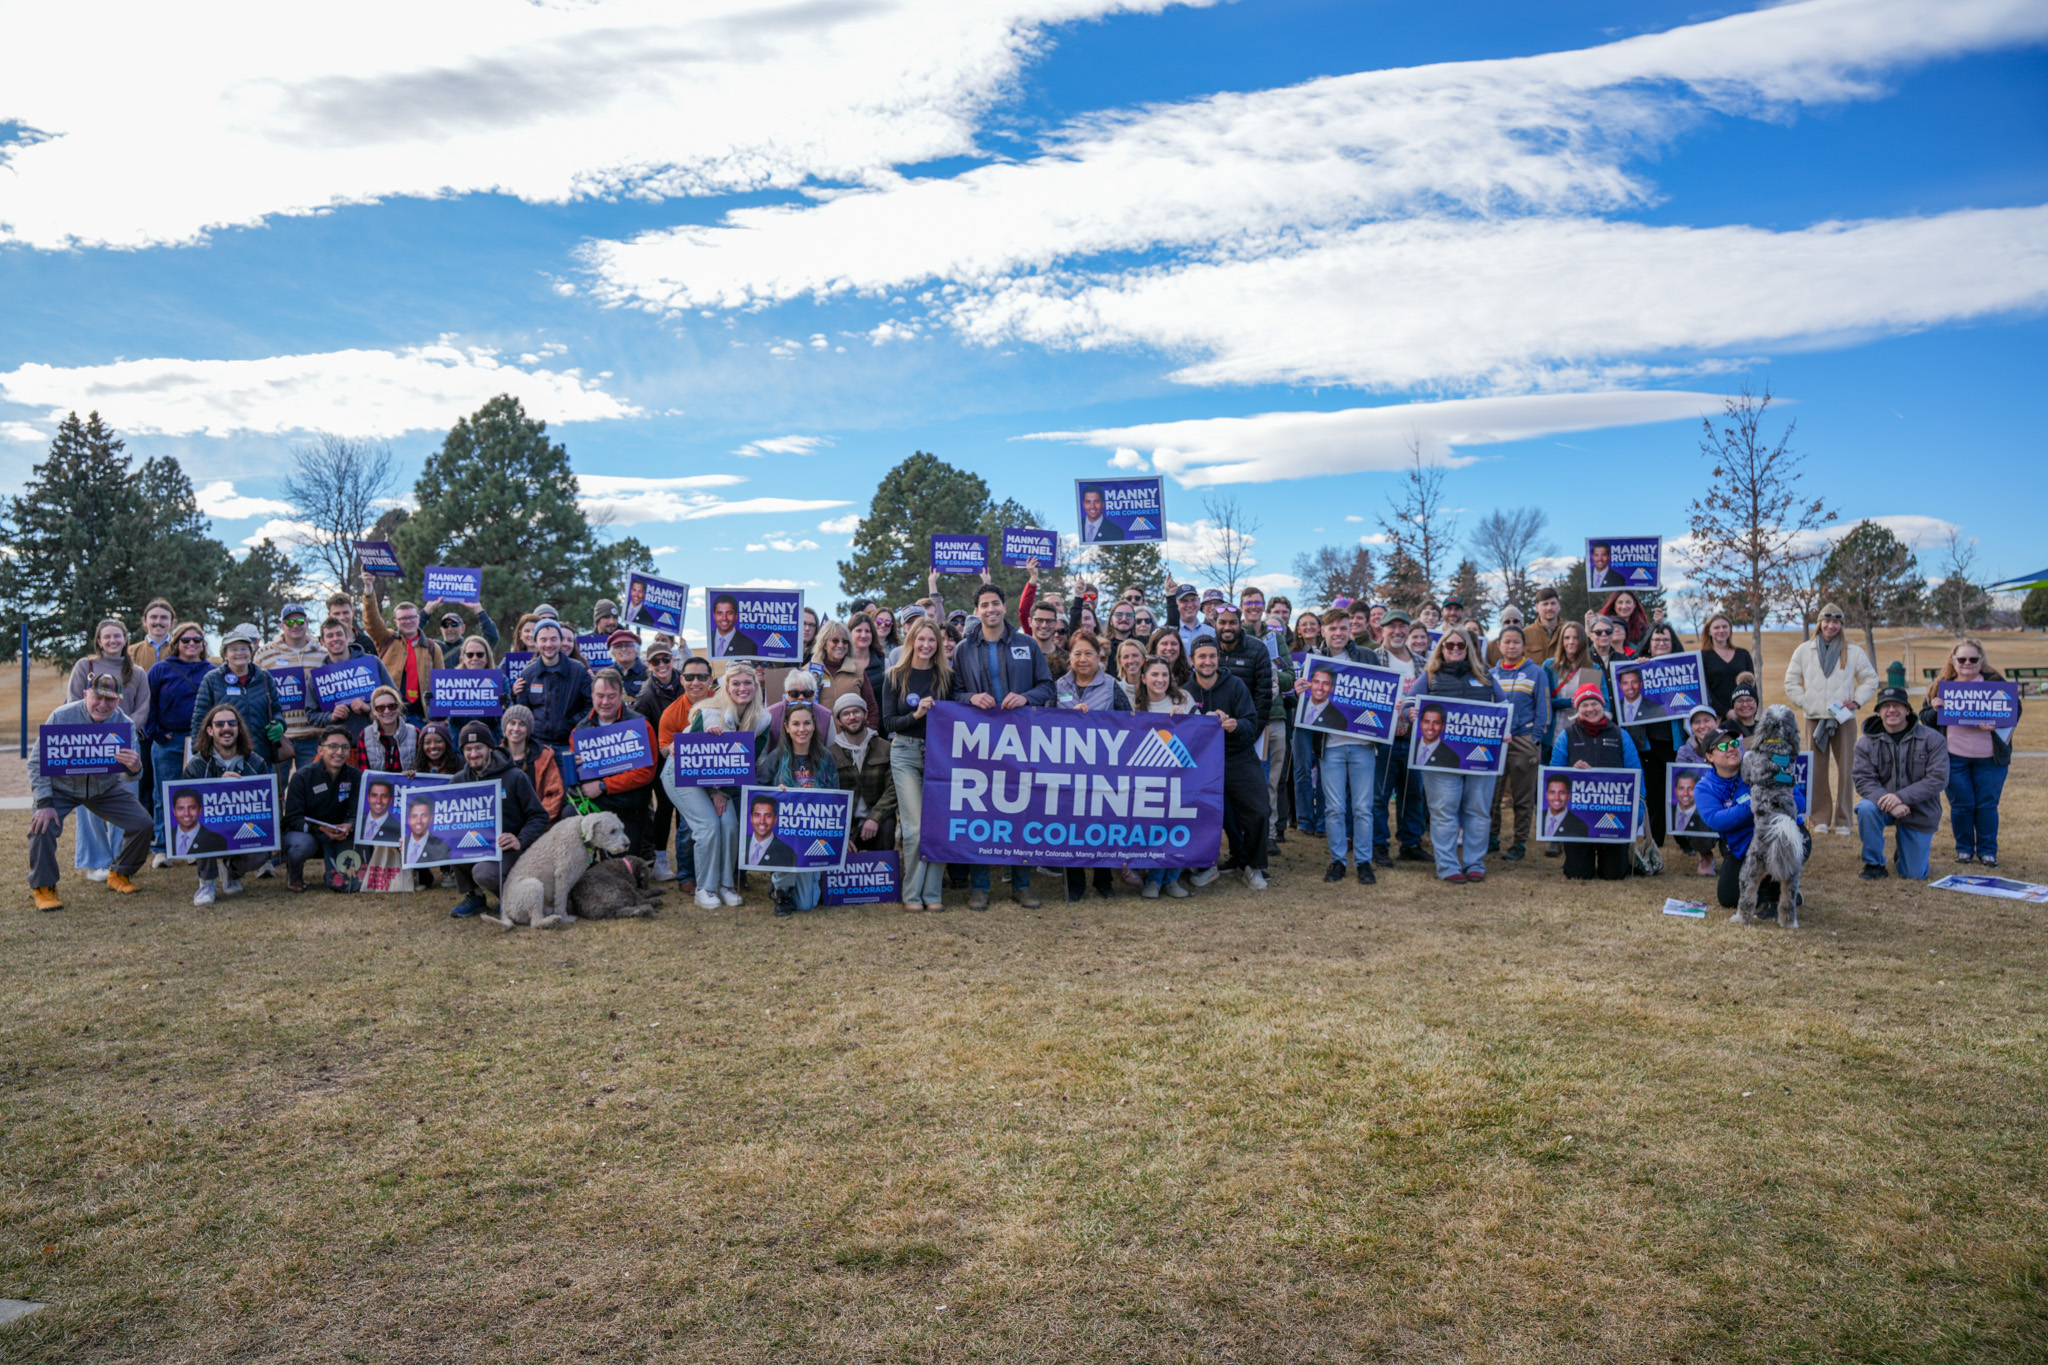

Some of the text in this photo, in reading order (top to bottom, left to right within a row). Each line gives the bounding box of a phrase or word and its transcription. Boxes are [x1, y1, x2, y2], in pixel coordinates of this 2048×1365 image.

[1105, 488, 1158, 500] MANNY
[1106, 499, 1159, 510] RUTINEL
[1007, 535, 1041, 544] MANNY
[356, 547, 380, 556] MANNY
[935, 542, 970, 550] MANNY
[1006, 544, 1053, 555] RUTINEL
[1611, 544, 1657, 554] MANNY
[361, 556, 397, 566] RUTINEL
[935, 551, 984, 560] RUTINEL
[1611, 554, 1657, 562] RUTINEL
[429, 573, 464, 582] MANNY
[428, 581, 477, 591] RUTINEL
[646, 584, 682, 601] MANNY
[645, 593, 681, 610] RUTINEL
[739, 601, 797, 614] MANNY
[739, 613, 797, 624] RUTINEL
[756, 624, 797, 632] CONGRESS
[580, 642, 608, 650] MANN
[316, 668, 354, 686] MANNY
[1642, 663, 1696, 680] MANNY
[319, 675, 376, 697] RUTINEL
[436, 678, 481, 688] MANNY
[1336, 673, 1397, 695] MANNY
[1643, 674, 1698, 689] RUTINEL
[336, 685, 376, 699] COLORADO
[436, 689, 498, 700] RUTINEL
[1660, 684, 1699, 693] CONGRESS
[1334, 685, 1394, 706] RUTINEL
[1944, 690, 1992, 700] MANNY
[1333, 696, 1393, 712] FOR CONGRESS
[1944, 700, 2012, 712] RUTINEL
[1446, 711, 1506, 728] MANNY
[1445, 724, 1503, 738] RUTINEL
[47, 734, 103, 745] MANNY
[578, 732, 623, 750] MANNY
[952, 721, 1130, 766] MANNY
[1462, 736, 1501, 745] CONGRESS
[580, 740, 644, 762] RUTINEL
[680, 743, 729, 754] MANNY
[48, 757, 117, 766] FOR COLORAD
[583, 761, 599, 769] FOR
[601, 751, 644, 765] COLORADO
[680, 755, 750, 768] RUTINEL
[1572, 780, 1633, 794] MANNY
[202, 789, 270, 806] MANNY
[950, 768, 1198, 819] RUTINEL
[1572, 793, 1632, 806] RUTINEL
[204, 802, 271, 817] RUTINEL
[435, 795, 495, 814] MANNY
[779, 802, 846, 818] MANNY
[204, 812, 272, 824] FOR CONGRESS
[433, 809, 495, 825] RUTINEL
[778, 816, 844, 829] RUTINEL
[451, 821, 495, 830] CONGRESS
[798, 829, 844, 837] CONGRESS
[949, 818, 1190, 848] FOR COLORADO
[1013, 849, 1033, 857] Manny
[1045, 850, 1074, 858] Colorado,
[1075, 851, 1095, 859] Manny
[1149, 852, 1166, 860] Agent
[827, 873, 894, 888] RUTINEL
[847, 886, 893, 894] COLORADO
